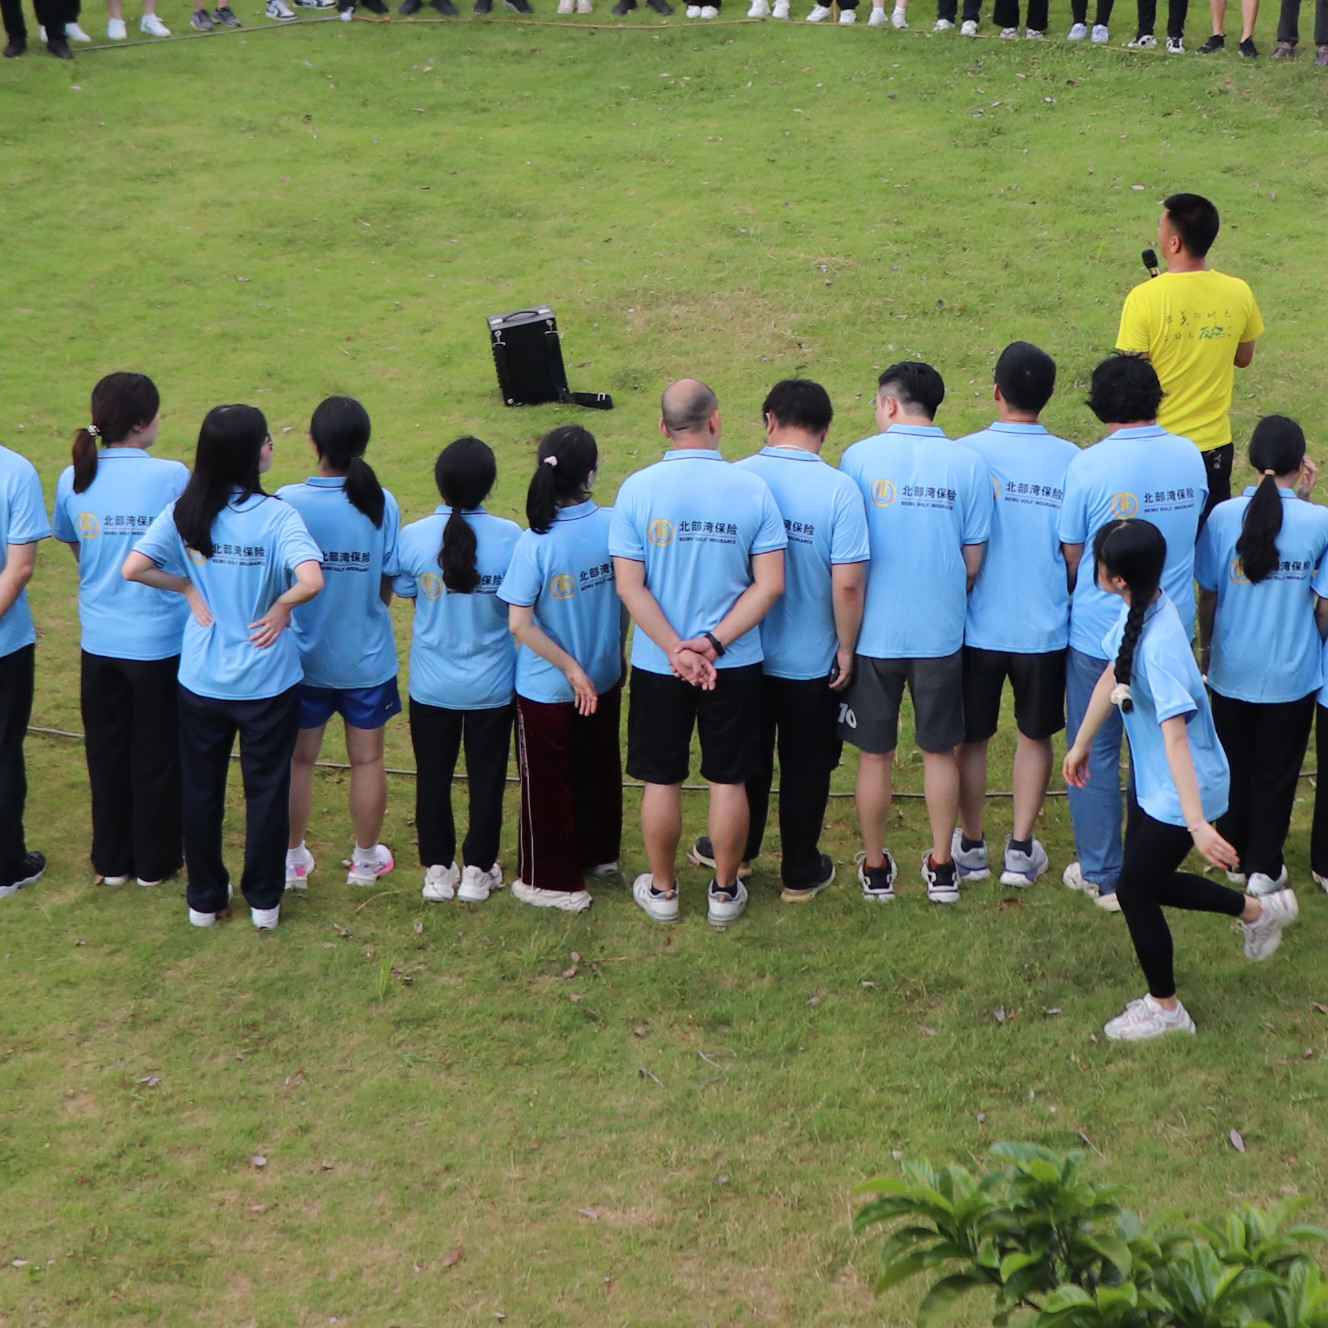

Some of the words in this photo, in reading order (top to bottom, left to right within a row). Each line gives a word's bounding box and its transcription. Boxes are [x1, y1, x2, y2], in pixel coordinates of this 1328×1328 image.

[902, 485, 957, 501] 北部湾保险
[1006, 481, 1064, 501] 北部湾保险
[1143, 488, 1195, 503] 北部湾保险
[679, 520, 738, 535] 北部湾保险
[579, 560, 614, 582] 北部湾
